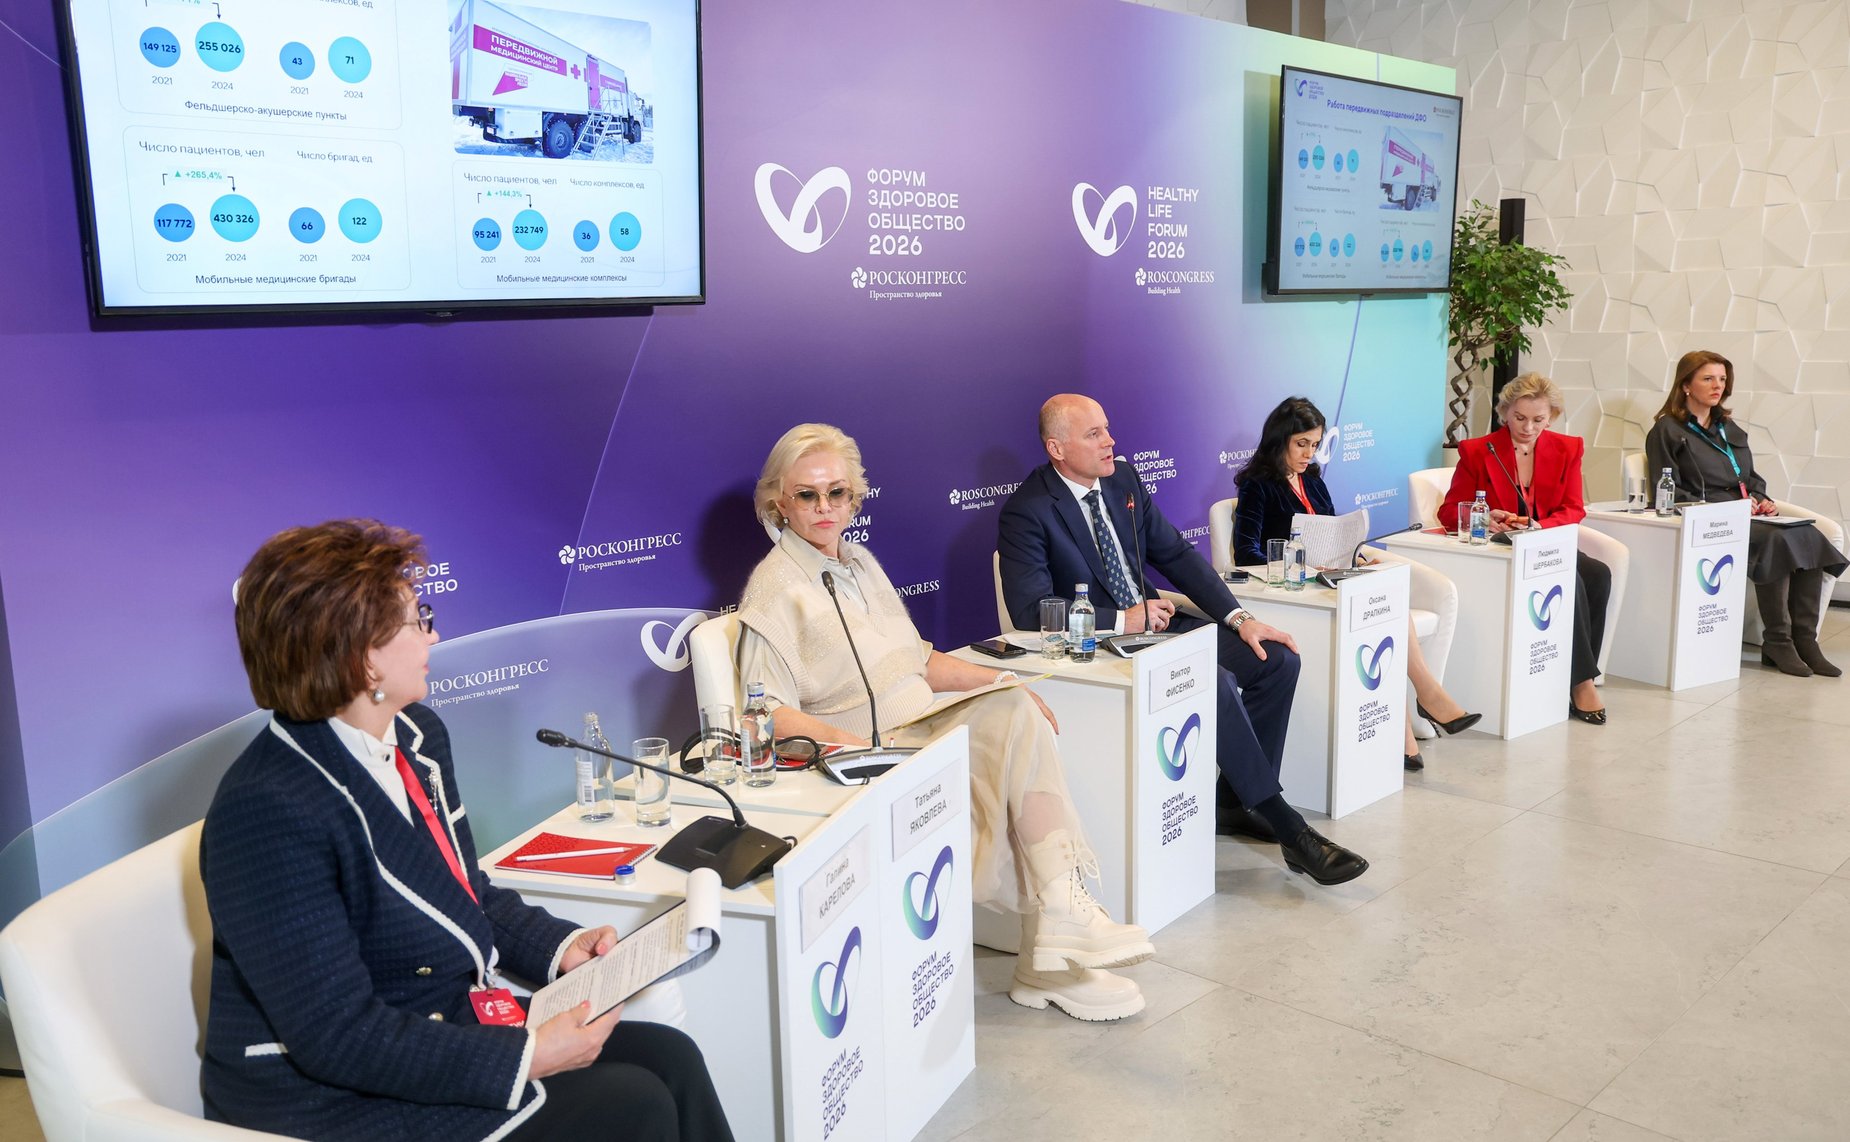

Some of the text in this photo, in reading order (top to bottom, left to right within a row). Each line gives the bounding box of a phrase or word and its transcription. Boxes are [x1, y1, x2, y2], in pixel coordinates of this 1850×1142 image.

[143, 42, 177, 53] 149 125
[199, 41, 241, 54] 255 026
[491, 35, 558, 65] ПЕРЕДВИЖНОЙ
[292, 57, 303, 66] 43
[345, 56, 355, 65] 71
[490, 45, 542, 66] МЕДИЦИНСКИЙ
[152, 76, 173, 85] 2021
[211, 81, 234, 90] 2024
[290, 86, 309, 95] 2021
[343, 90, 364, 99] 2024
[184, 100, 347, 121] Фельдшерско-акушерские пункты
[1327, 99, 1345, 110] Работа
[139, 141, 265, 158] Число пациентов, чел
[297, 150, 326, 161] Число
[362, 155, 373, 164] ед
[185, 170, 223, 181] +265,4%
[464, 172, 493, 183] Число
[542, 177, 557, 185] чел
[570, 178, 592, 187] Число
[867, 167, 926, 188] ФОРУМ
[868, 189, 959, 209] ЗДОРОВОЕ
[1148, 186, 1199, 202] HEALTHY
[1148, 204, 1172, 218] LIFE
[157, 218, 192, 229] 117 772
[213, 214, 254, 224] 430 326
[301, 221, 313, 231] 66
[352, 217, 367, 226] 122
[868, 212, 966, 233] ОБЩЕСТВО
[475, 231, 499, 239] 95 241
[515, 226, 544, 234] 232 749
[582, 232, 591, 240] 36
[620, 228, 629, 236] 58
[1148, 223, 1188, 237] FORUM
[869, 234, 923, 256] 2026
[1147, 241, 1185, 259] 2026
[166, 253, 187, 262] 2021
[225, 253, 246, 262] 2024
[299, 254, 318, 262] 2021
[351, 254, 371, 262] 2024
[481, 256, 496, 264] 2021
[195, 273, 357, 286] Мобильные медицинские бригады
[496, 274, 627, 284] Мобильные медицинские комплексы
[869, 269, 967, 286] РОСКОНГРЕСС
[1147, 269, 1215, 283] ROSCONGRESS
[869, 289, 943, 300] Пространство здоровья
[1147, 286, 1181, 296] Building Health
[1343, 422, 1363, 431] ФОРУМ
[1133, 450, 1160, 461] ФОРУМ
[1343, 451, 1360, 462] 2026
[1133, 458, 1174, 472] ЗДОРОВОЕ
[1139, 469, 1176, 482] БЩЕСТВО
[961, 482, 1023, 501] ROSCONGRE
[1146, 483, 1157, 494] 26
[962, 499, 995, 511] Building Health
[848, 516, 871, 528] RUM
[842, 529, 869, 543] 026
[578, 533, 682, 559] РОСКОНГРЕСС
[578, 554, 656, 572] Пространство здоровья
[413, 579, 458, 596] СТВО
[895, 580, 940, 597] ONGRESS
[1368, 594, 1386, 605] Оксана
[1362, 605, 1391, 621] ДРАПКИНА
[1697, 625, 1714, 635] 2026
[430, 658, 549, 695] РОСКОНГРЕСС
[1170, 665, 1191, 681] Виктор
[1529, 664, 1545, 675] 2026
[431, 683, 520, 707] Пространство здоровья
[1166, 678, 1195, 699] ФИСЕНКО
[1358, 704, 1388, 723] ЗДОРОВОЕ
[1359, 700, 1378, 713] ФОРУМ
[1358, 714, 1391, 732] ОБЩЕСТВО
[1358, 729, 1376, 743] 2026
[915, 784, 942, 809] Татьяна
[1162, 791, 1184, 810] ФОРУМ
[1162, 795, 1196, 821] ЗДОРОВОЕ
[910, 800, 947, 835] ЯКОВЛЕВА
[1162, 805, 1199, 833] ОБЩЕСТВО
[1162, 827, 1182, 846] 2026
[825, 857, 850, 889] Галина
[819, 875, 856, 920] КАРЕЛОВА
[912, 951, 938, 981] ФОРУМ
[912, 951, 951, 995] ЗДОРОВОЕ
[912, 966, 954, 1011] ОБЩЕСТВО
[913, 1000, 936, 1029] 2026
[821, 1047, 847, 1087] ФОРУМ
[822, 1046, 860, 1105] ЗДОРОВОЕ
[822, 1059, 864, 1121] ОБЩЕСТВО
[823, 1102, 847, 1141] 2026
